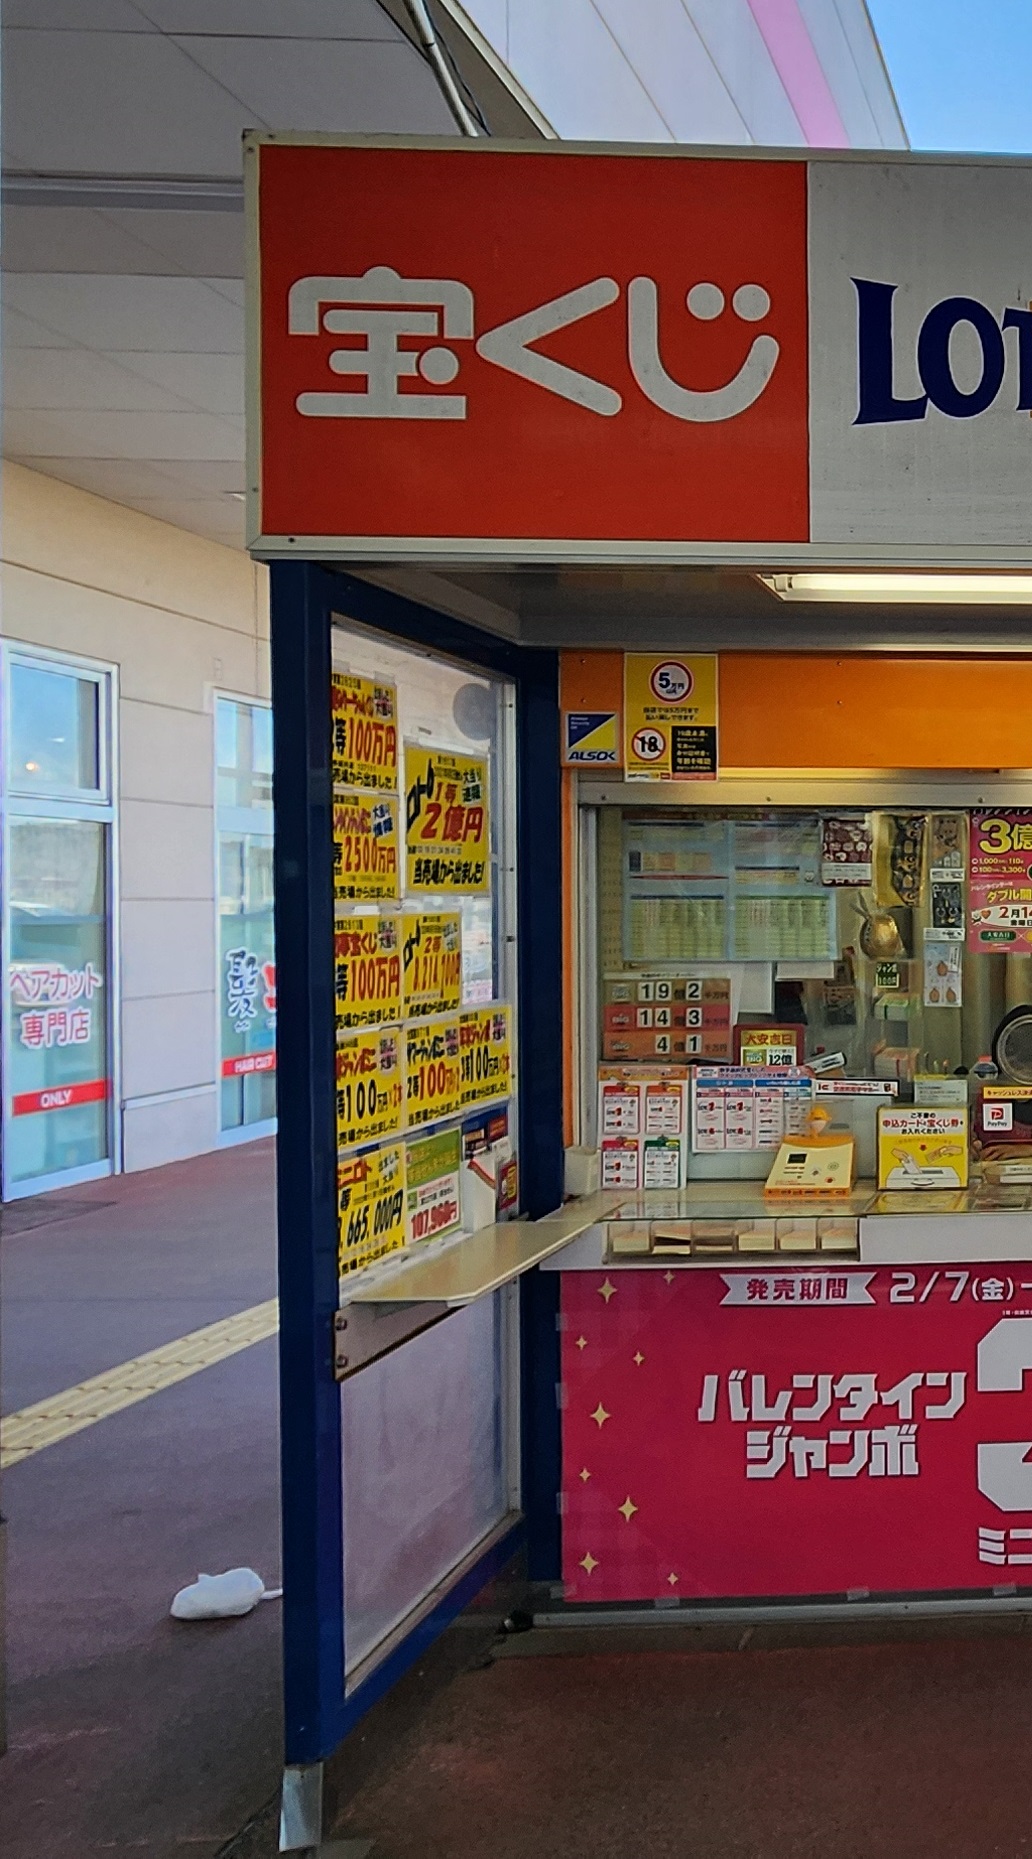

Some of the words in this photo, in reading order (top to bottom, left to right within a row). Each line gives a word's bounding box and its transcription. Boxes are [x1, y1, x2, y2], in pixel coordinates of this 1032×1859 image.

[288, 266, 779, 422] 宝くじ
[568, 751, 616, 761] ALSOK
[640, 736, 659, 752] 18
[420, 802, 484, 842] 2億円
[10, 963, 100, 999] ヘアカット
[22, 1008, 90, 1046] 専門店
[745, 1034, 793, 1045] 大安吉日
[41, 1089, 72, 1107] ONLY
[747, 1278, 848, 1300] 発売期間
[698, 1370, 966, 1422] バレンタイン
[746, 1425, 919, 1478] ジャンボ
